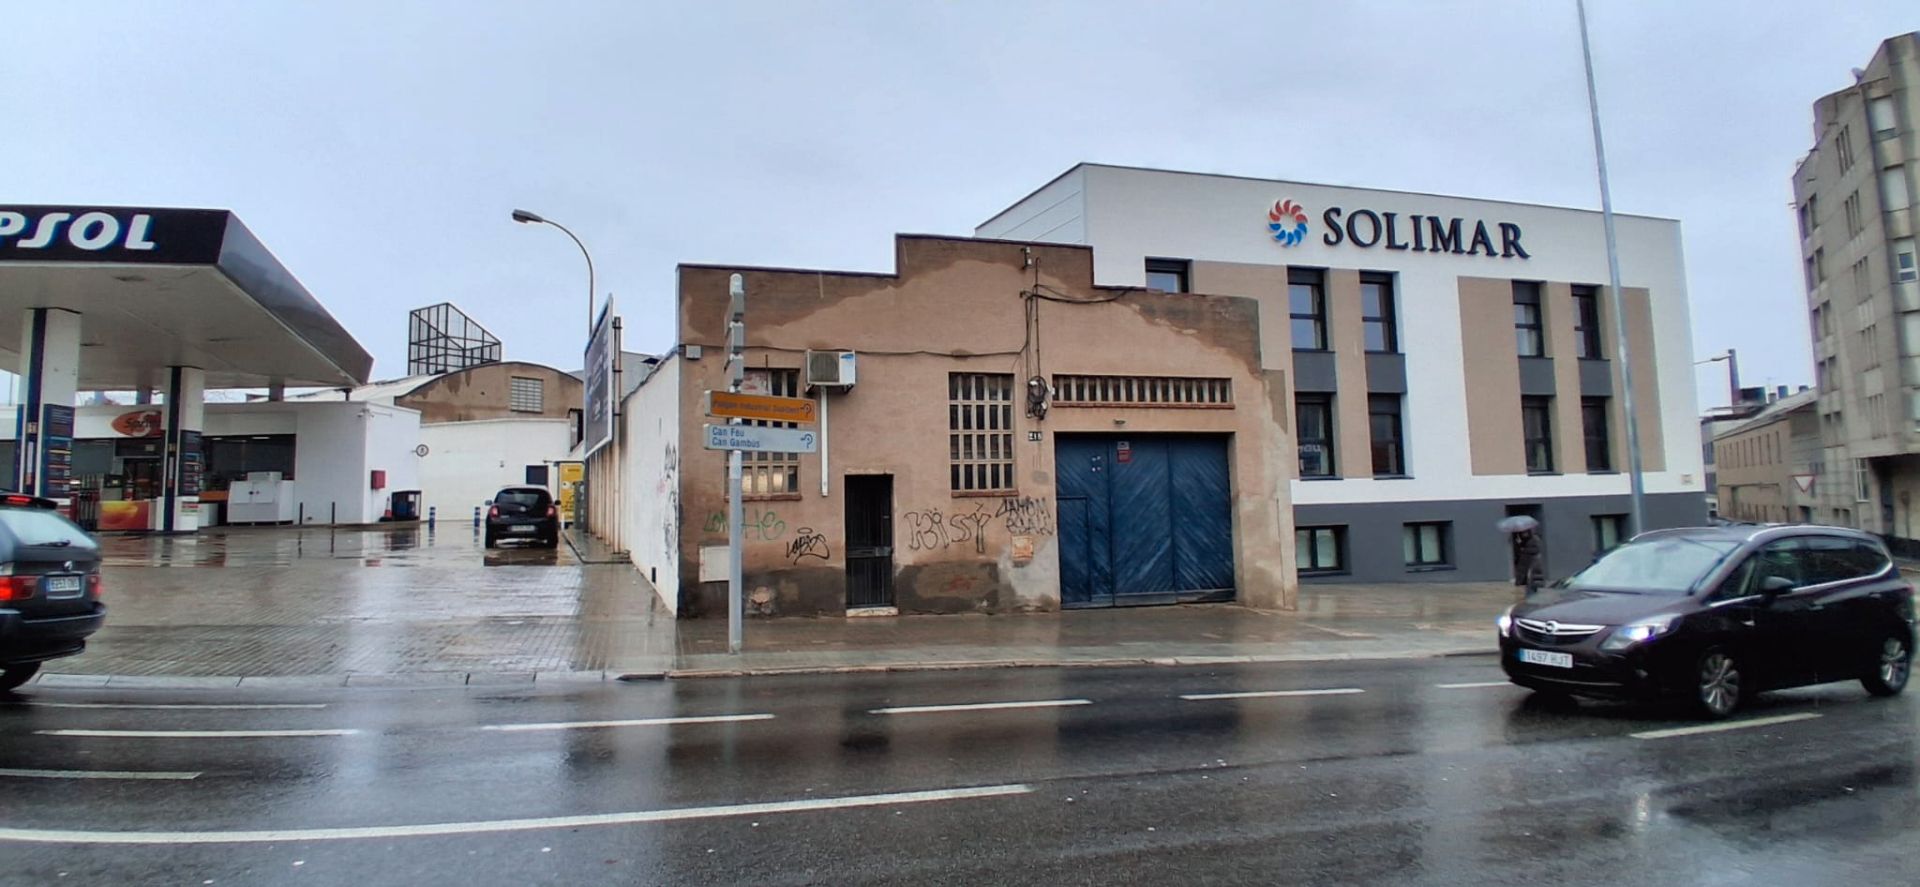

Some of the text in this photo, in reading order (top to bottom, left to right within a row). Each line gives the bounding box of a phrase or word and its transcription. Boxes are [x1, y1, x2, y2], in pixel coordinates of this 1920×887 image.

[0, 210, 156, 250] PSOL
[1322, 206, 1531, 260] SOLIMAR
[712, 427, 728, 436] Can
[712, 437, 728, 446] Can
